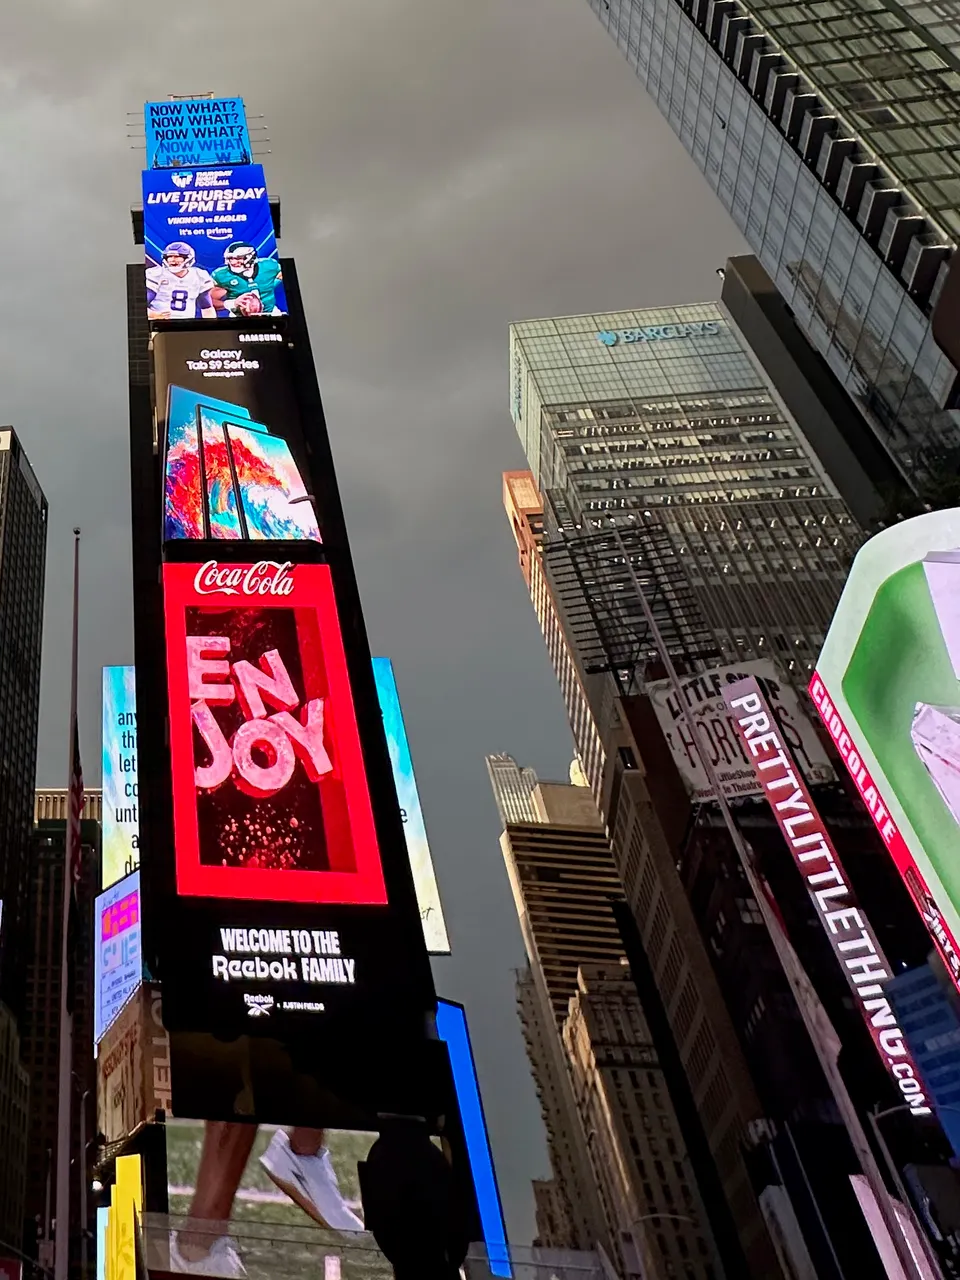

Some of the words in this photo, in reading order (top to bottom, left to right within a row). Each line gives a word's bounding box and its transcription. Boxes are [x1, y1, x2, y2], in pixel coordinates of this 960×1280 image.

[150, 104, 184, 117] NOW
[185, 100, 237, 115] WHAT?
[151, 115, 185, 128] NOW
[187, 112, 240, 126] WHAT?
[155, 128, 191, 141] NOW
[192, 125, 244, 139] WHAT?
[160, 140, 196, 154] NOW
[147, 191, 180, 204] LIVE
[183, 187, 266, 202] THURSDAY
[178, 200, 214, 213] 7PM
[216, 199, 236, 211] ET
[167, 216, 204, 225] VIKINGS
[213, 214, 247, 223] EAGLES
[206, 227, 233, 236] prime
[170, 289, 188, 312] 8
[238, 334, 282, 342] SAMSUNG
[617, 321, 721, 344] BARCLAYS
[200, 349, 242, 361] Galaxy
[186, 360, 208, 371] Tab
[209, 360, 222, 371] S9
[223, 358, 260, 371] Series
[193, 560, 295, 597] Coca-Cola
[186, 636, 300, 720] EN
[190, 698, 334, 791] JOY
[811, 679, 897, 844] CHOCOLATE
[730, 691, 933, 1117] PRETTYLITTLETHING.COM
[220, 927, 291, 954] WELCOME
[291, 929, 312, 954] TO
[312, 930, 341, 955] THE
[212, 955, 297, 981] Reebok
[301, 958, 355, 983] FAMILY
[243, 993, 274, 1004] Reebok
